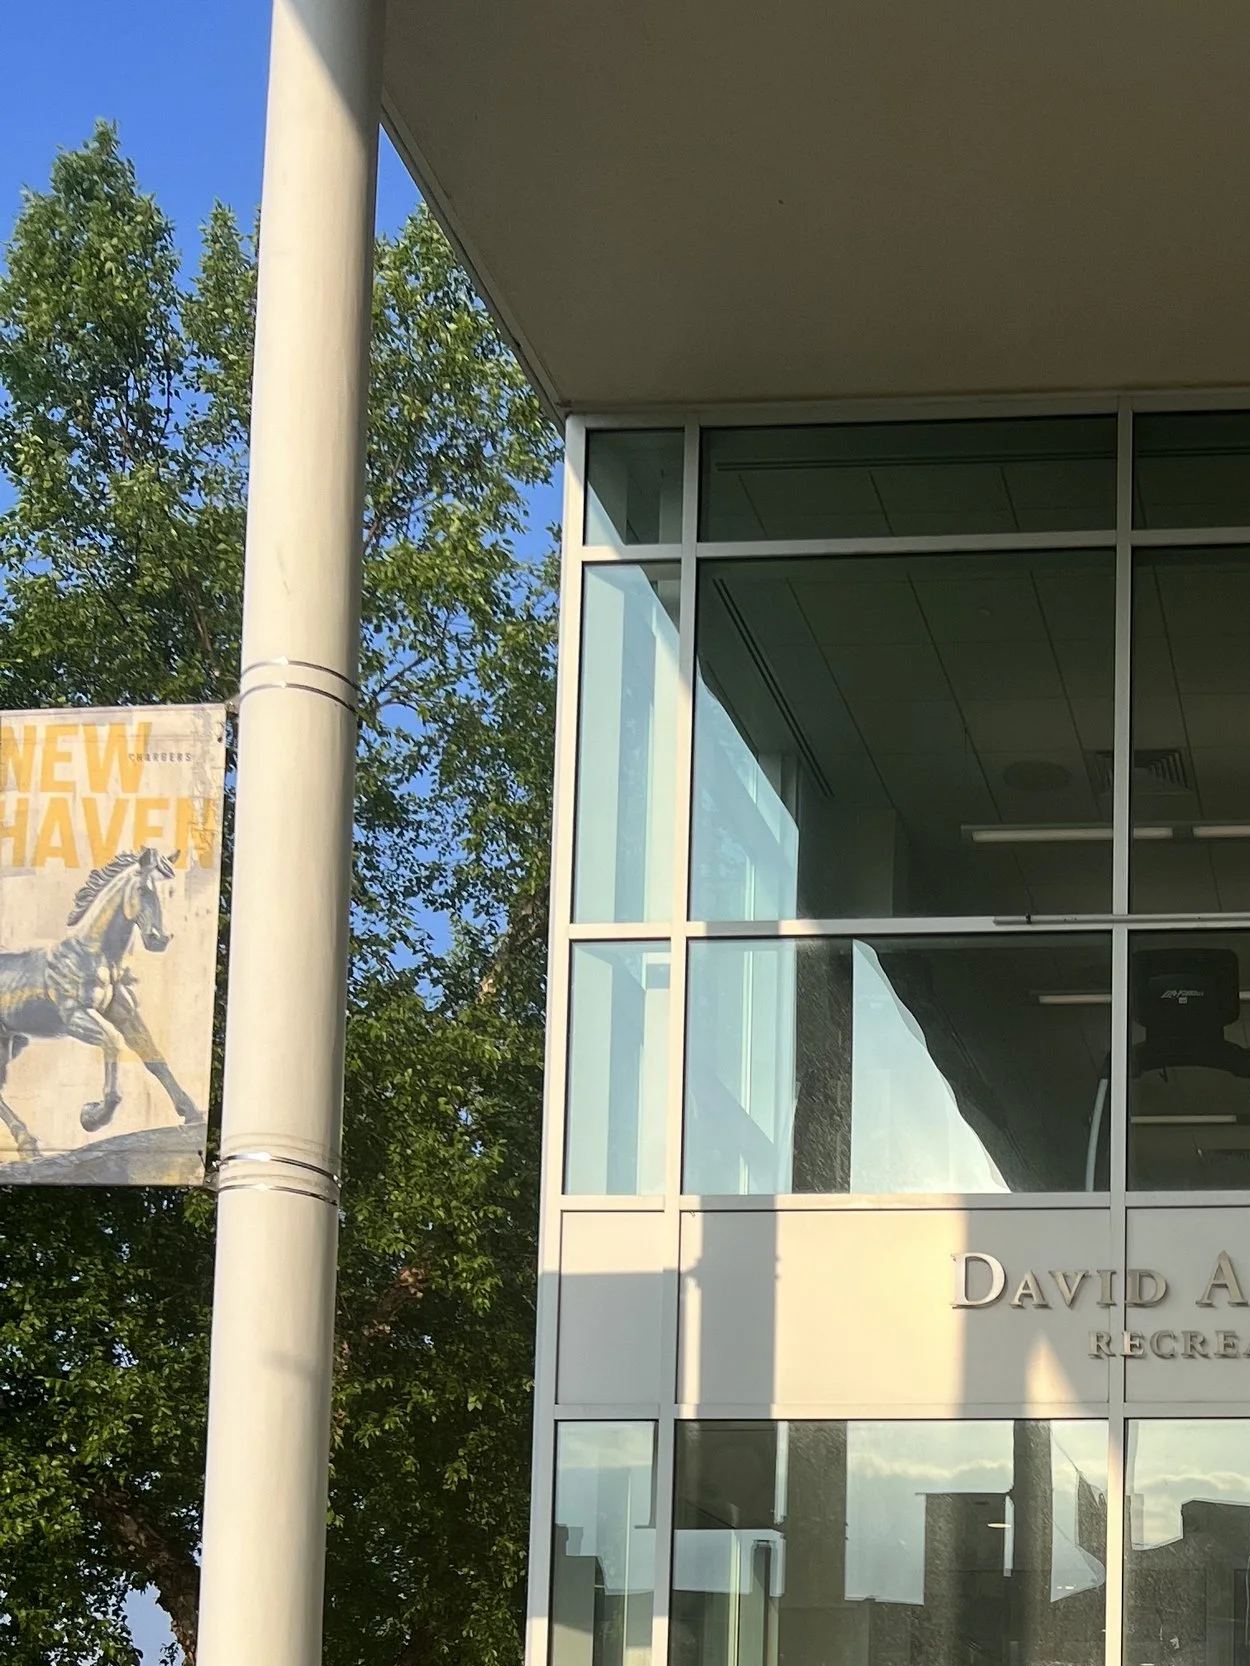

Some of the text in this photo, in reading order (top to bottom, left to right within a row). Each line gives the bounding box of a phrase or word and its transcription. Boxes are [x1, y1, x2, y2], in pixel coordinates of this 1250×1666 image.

[0, 722, 153, 793] NEW
[128, 752, 193, 763] CHARGERS
[0, 796, 217, 869] HAVEN
[950, 1251, 1168, 1309] DAVID
